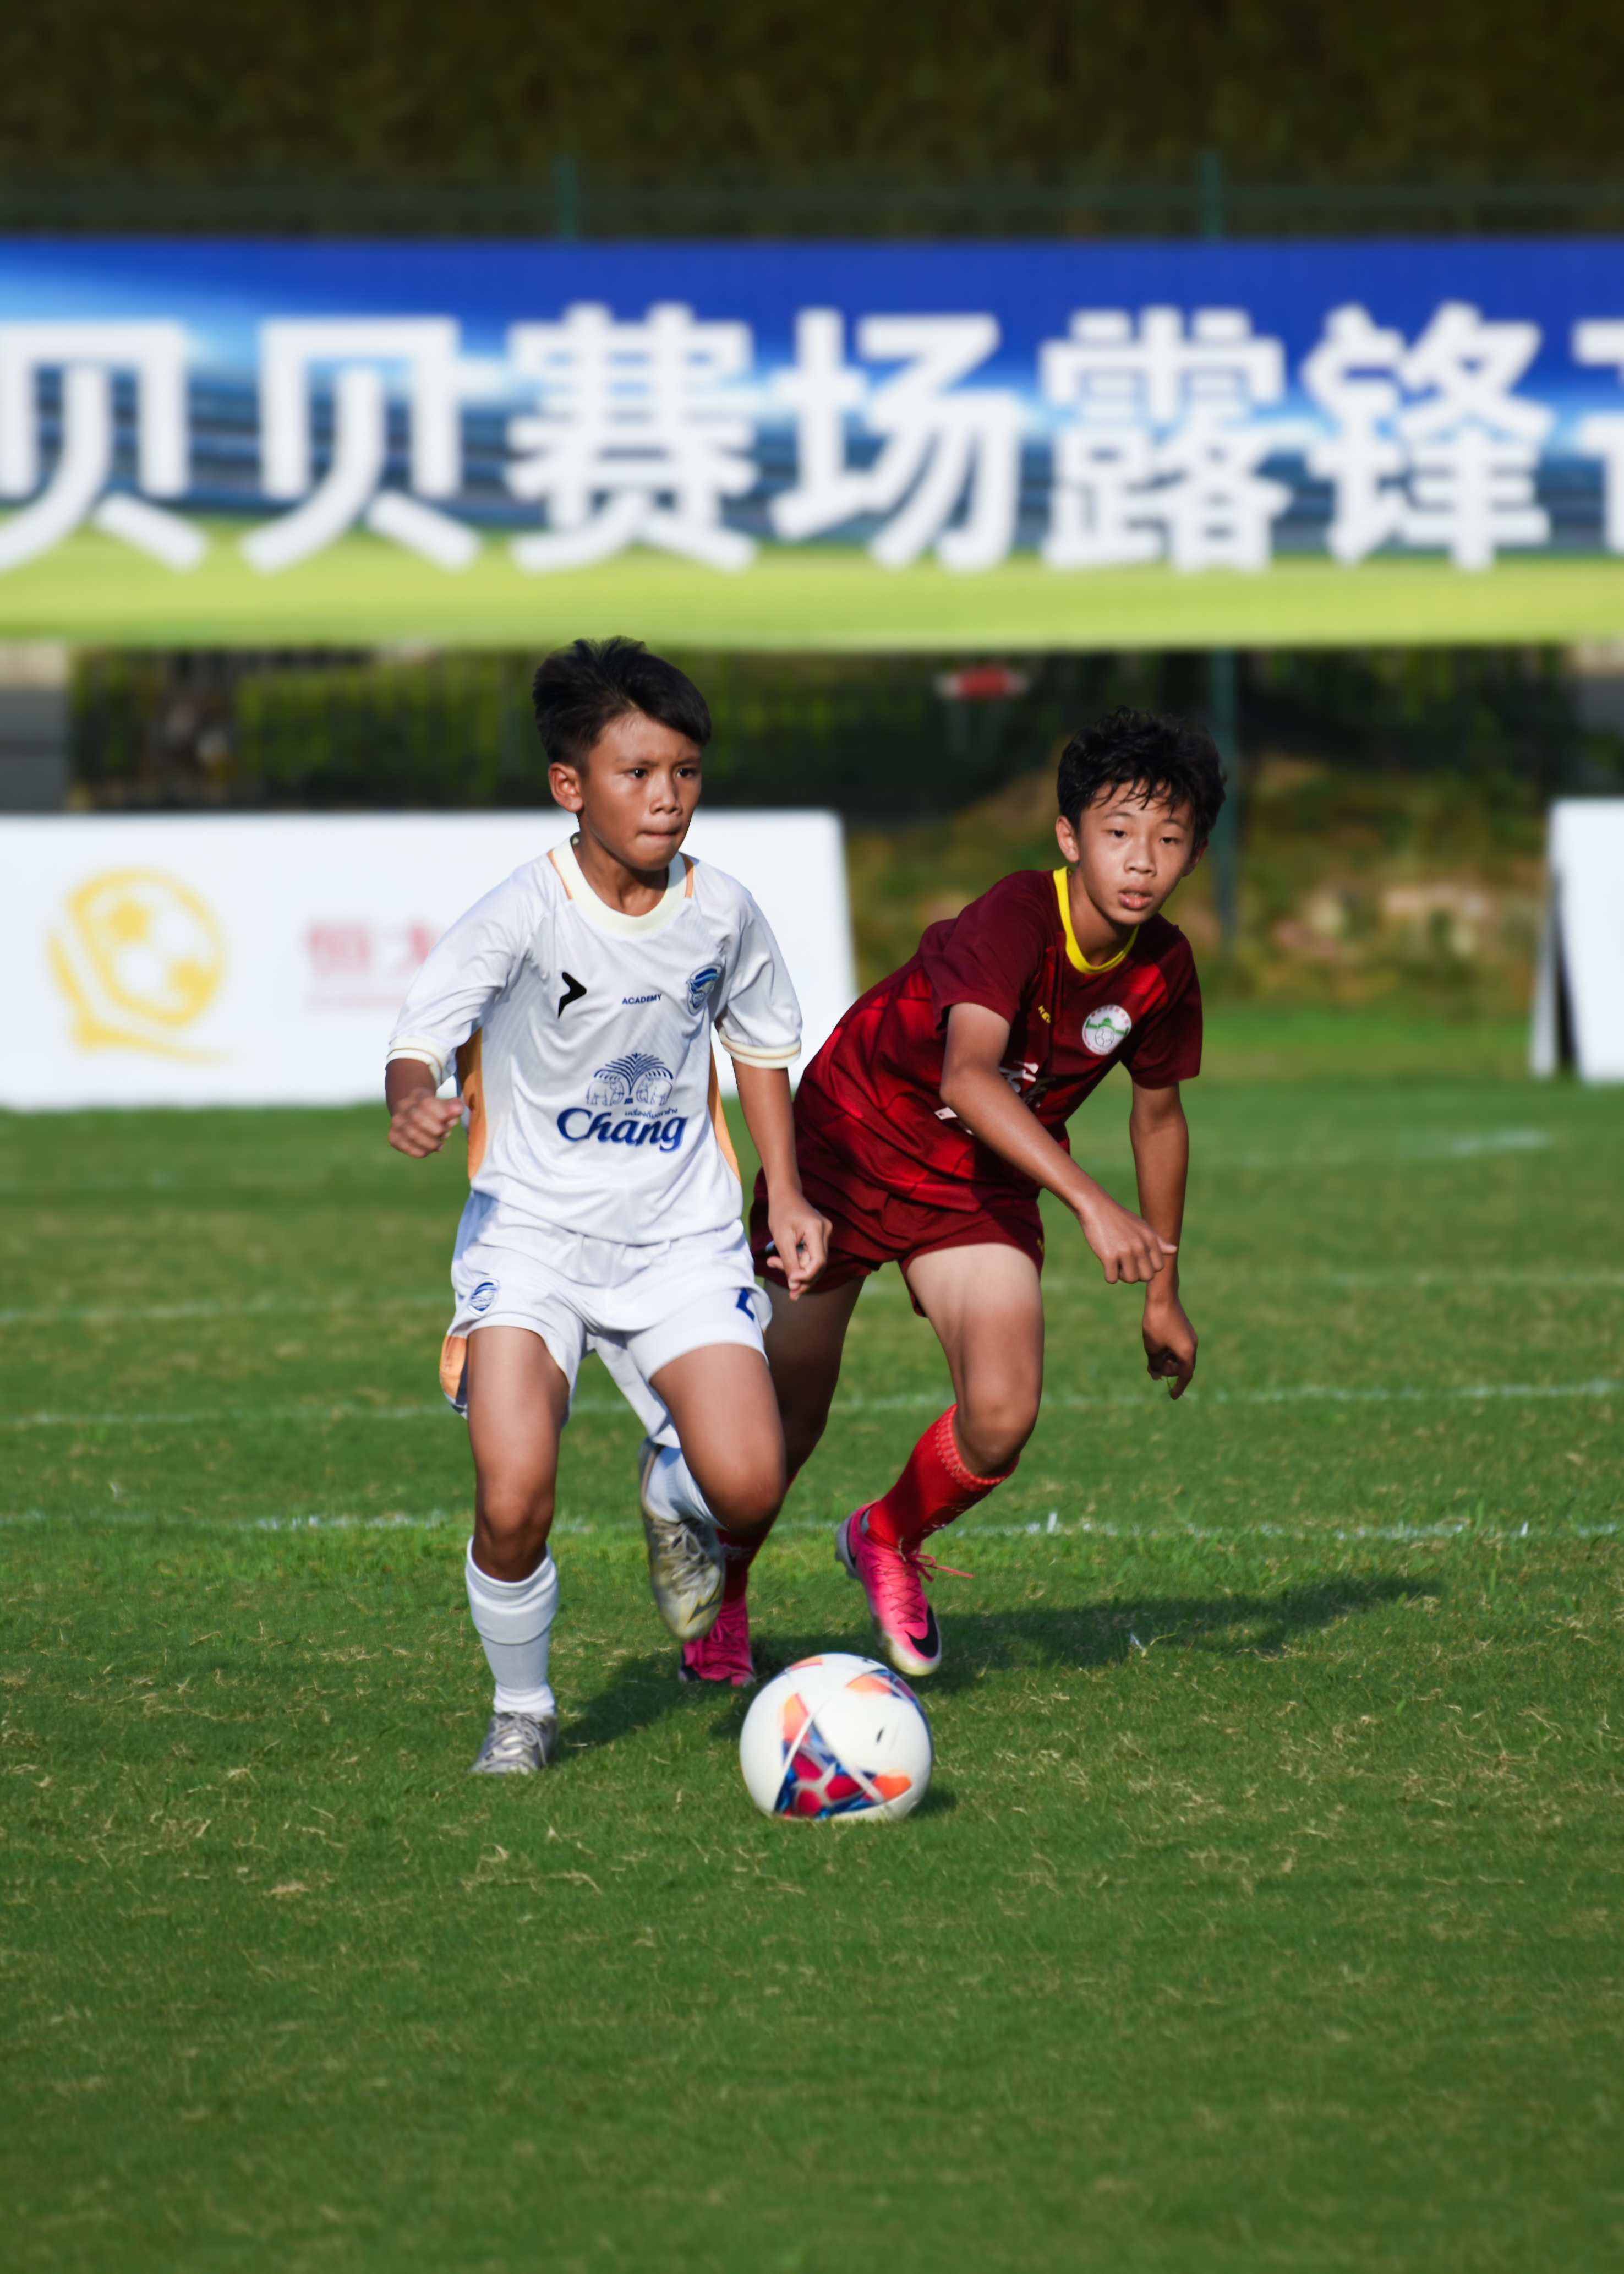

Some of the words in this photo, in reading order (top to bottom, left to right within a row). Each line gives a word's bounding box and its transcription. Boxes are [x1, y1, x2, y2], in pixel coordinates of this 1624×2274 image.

[0, 302, 1624, 572] 贝贝赛场露锋
[622, 993, 662, 1005] ACADEMY
[557, 1108, 688, 1153] Chang
